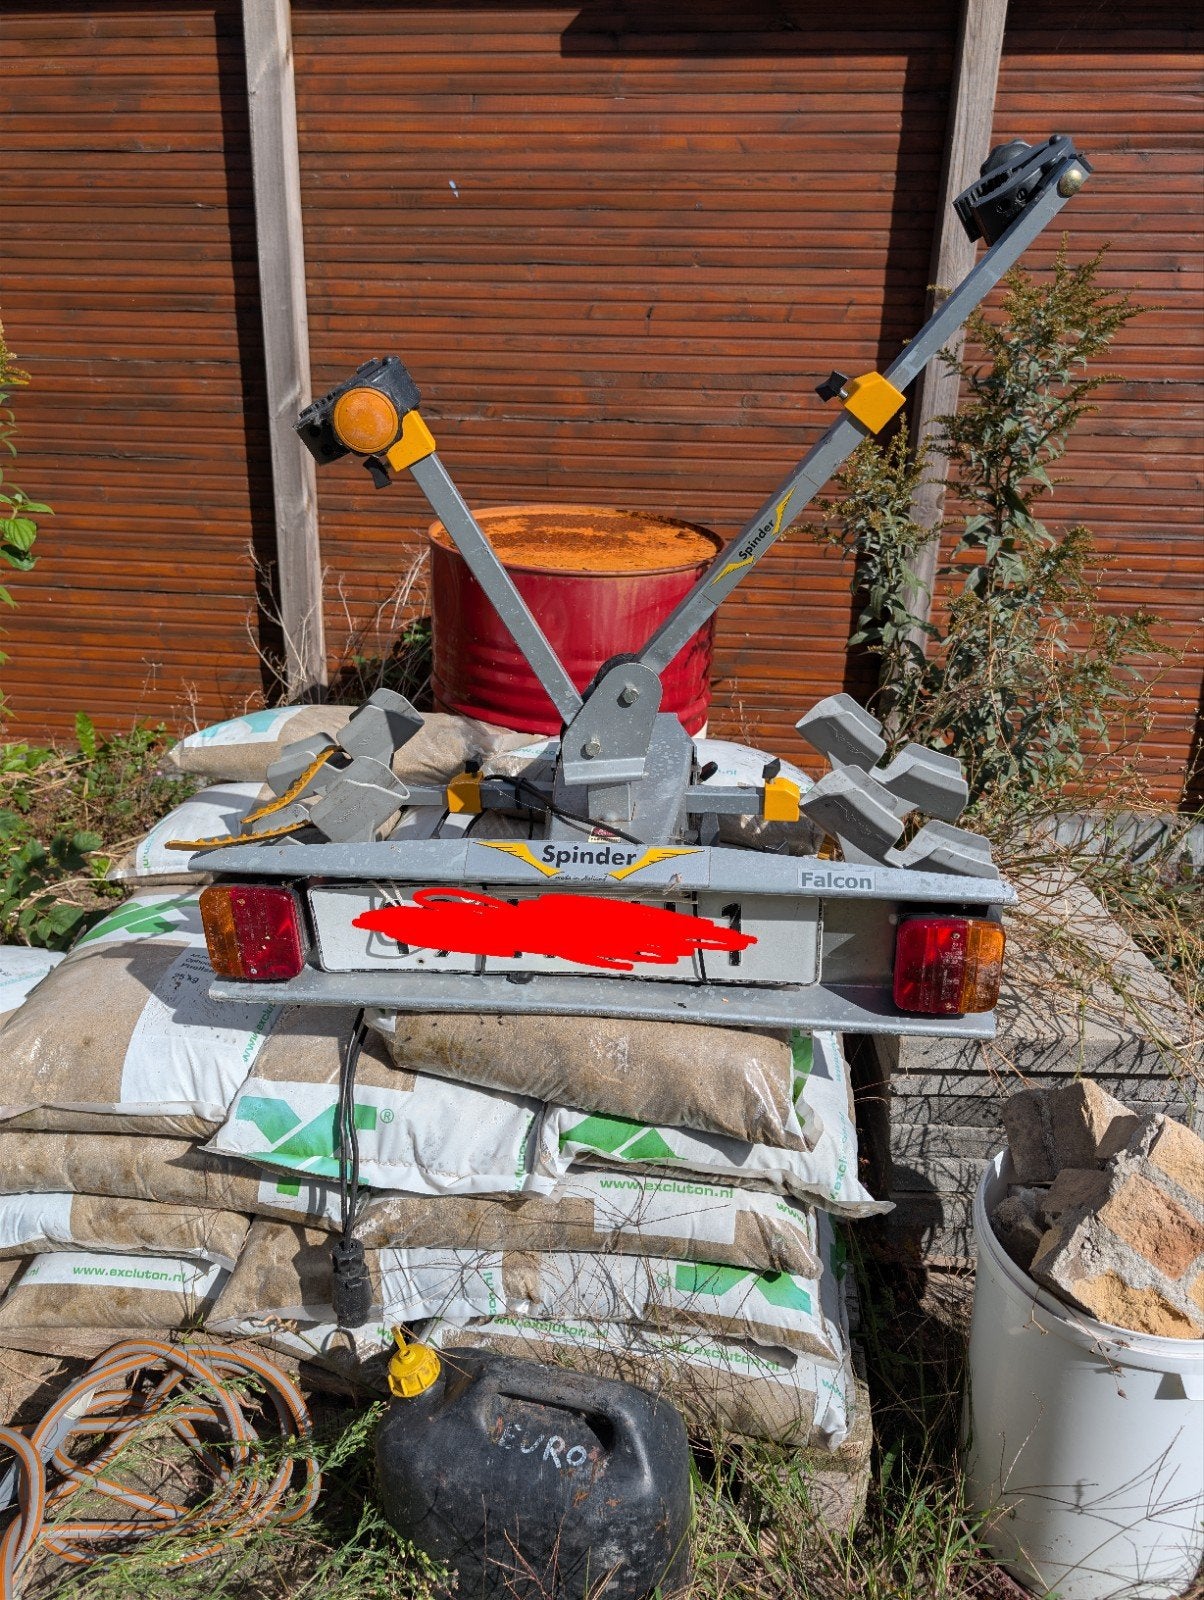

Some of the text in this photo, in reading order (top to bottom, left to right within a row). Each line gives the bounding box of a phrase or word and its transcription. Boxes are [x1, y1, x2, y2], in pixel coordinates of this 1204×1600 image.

[738, 519, 774, 560] Spinder
[541, 844, 637, 869] Spinder
[801, 871, 873, 890] Falcon
[599, 1178, 734, 1199] www.excluton.nl
[72, 1265, 187, 1283] www.excluton.nl
[498, 1422, 588, 1470] EURO
